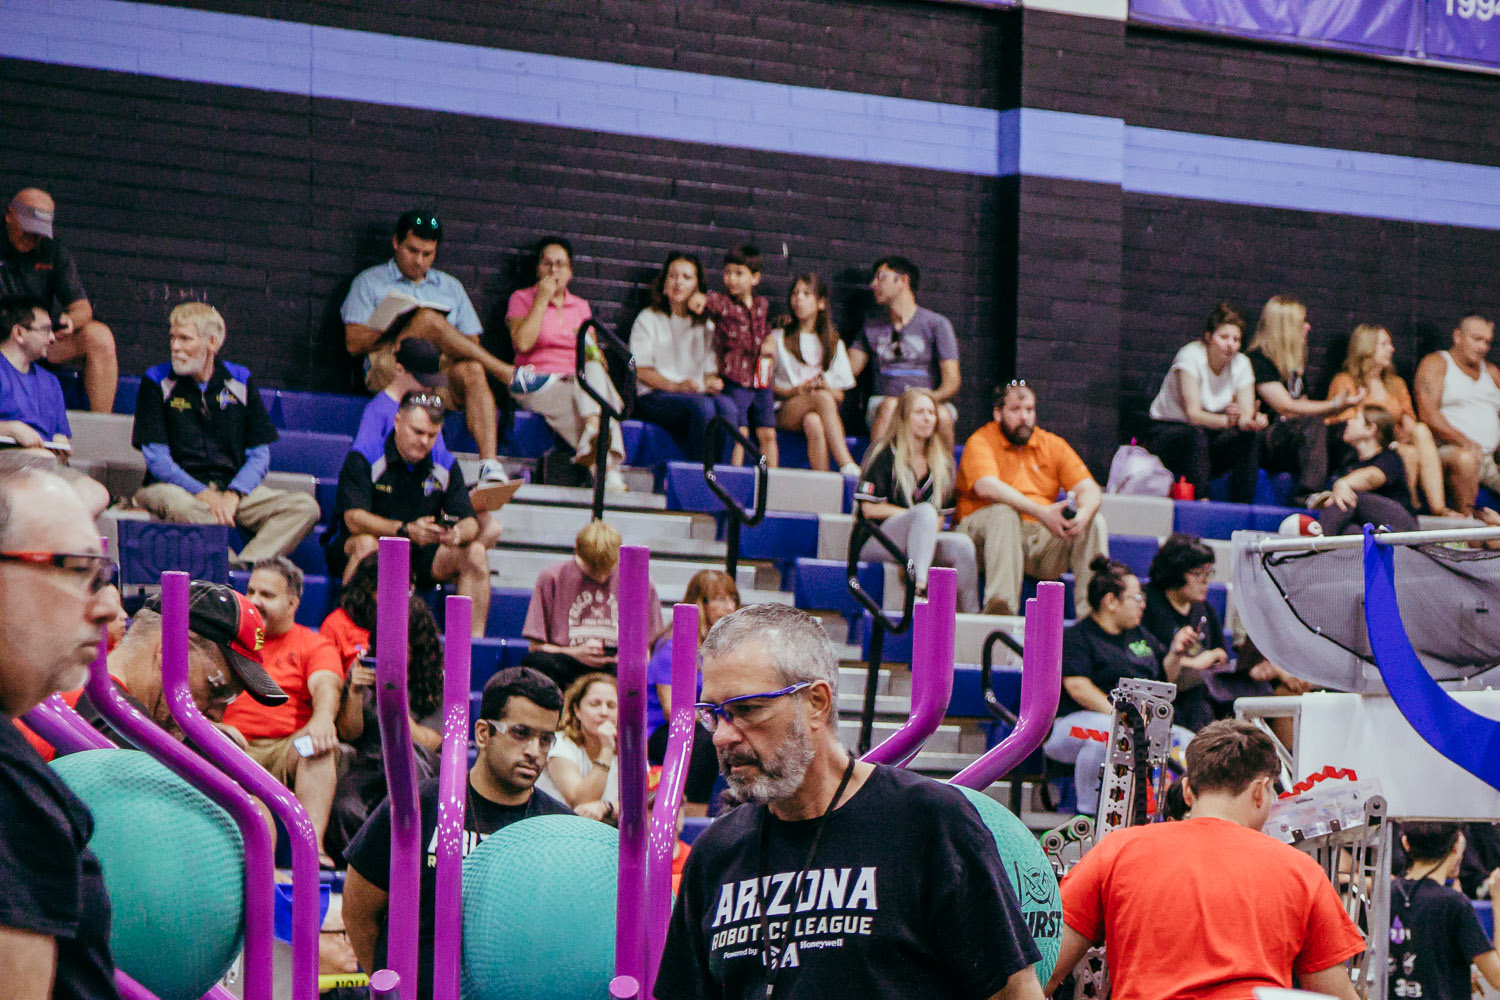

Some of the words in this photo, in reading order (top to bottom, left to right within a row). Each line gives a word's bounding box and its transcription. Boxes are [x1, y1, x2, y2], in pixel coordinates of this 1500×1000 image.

[711, 920, 790, 951] ROBOTC
[794, 916, 874, 937] LEAGUE
[723, 949, 747, 960] Powered
[748, 948, 758, 956] by
[800, 938, 844, 950] Honeywell
